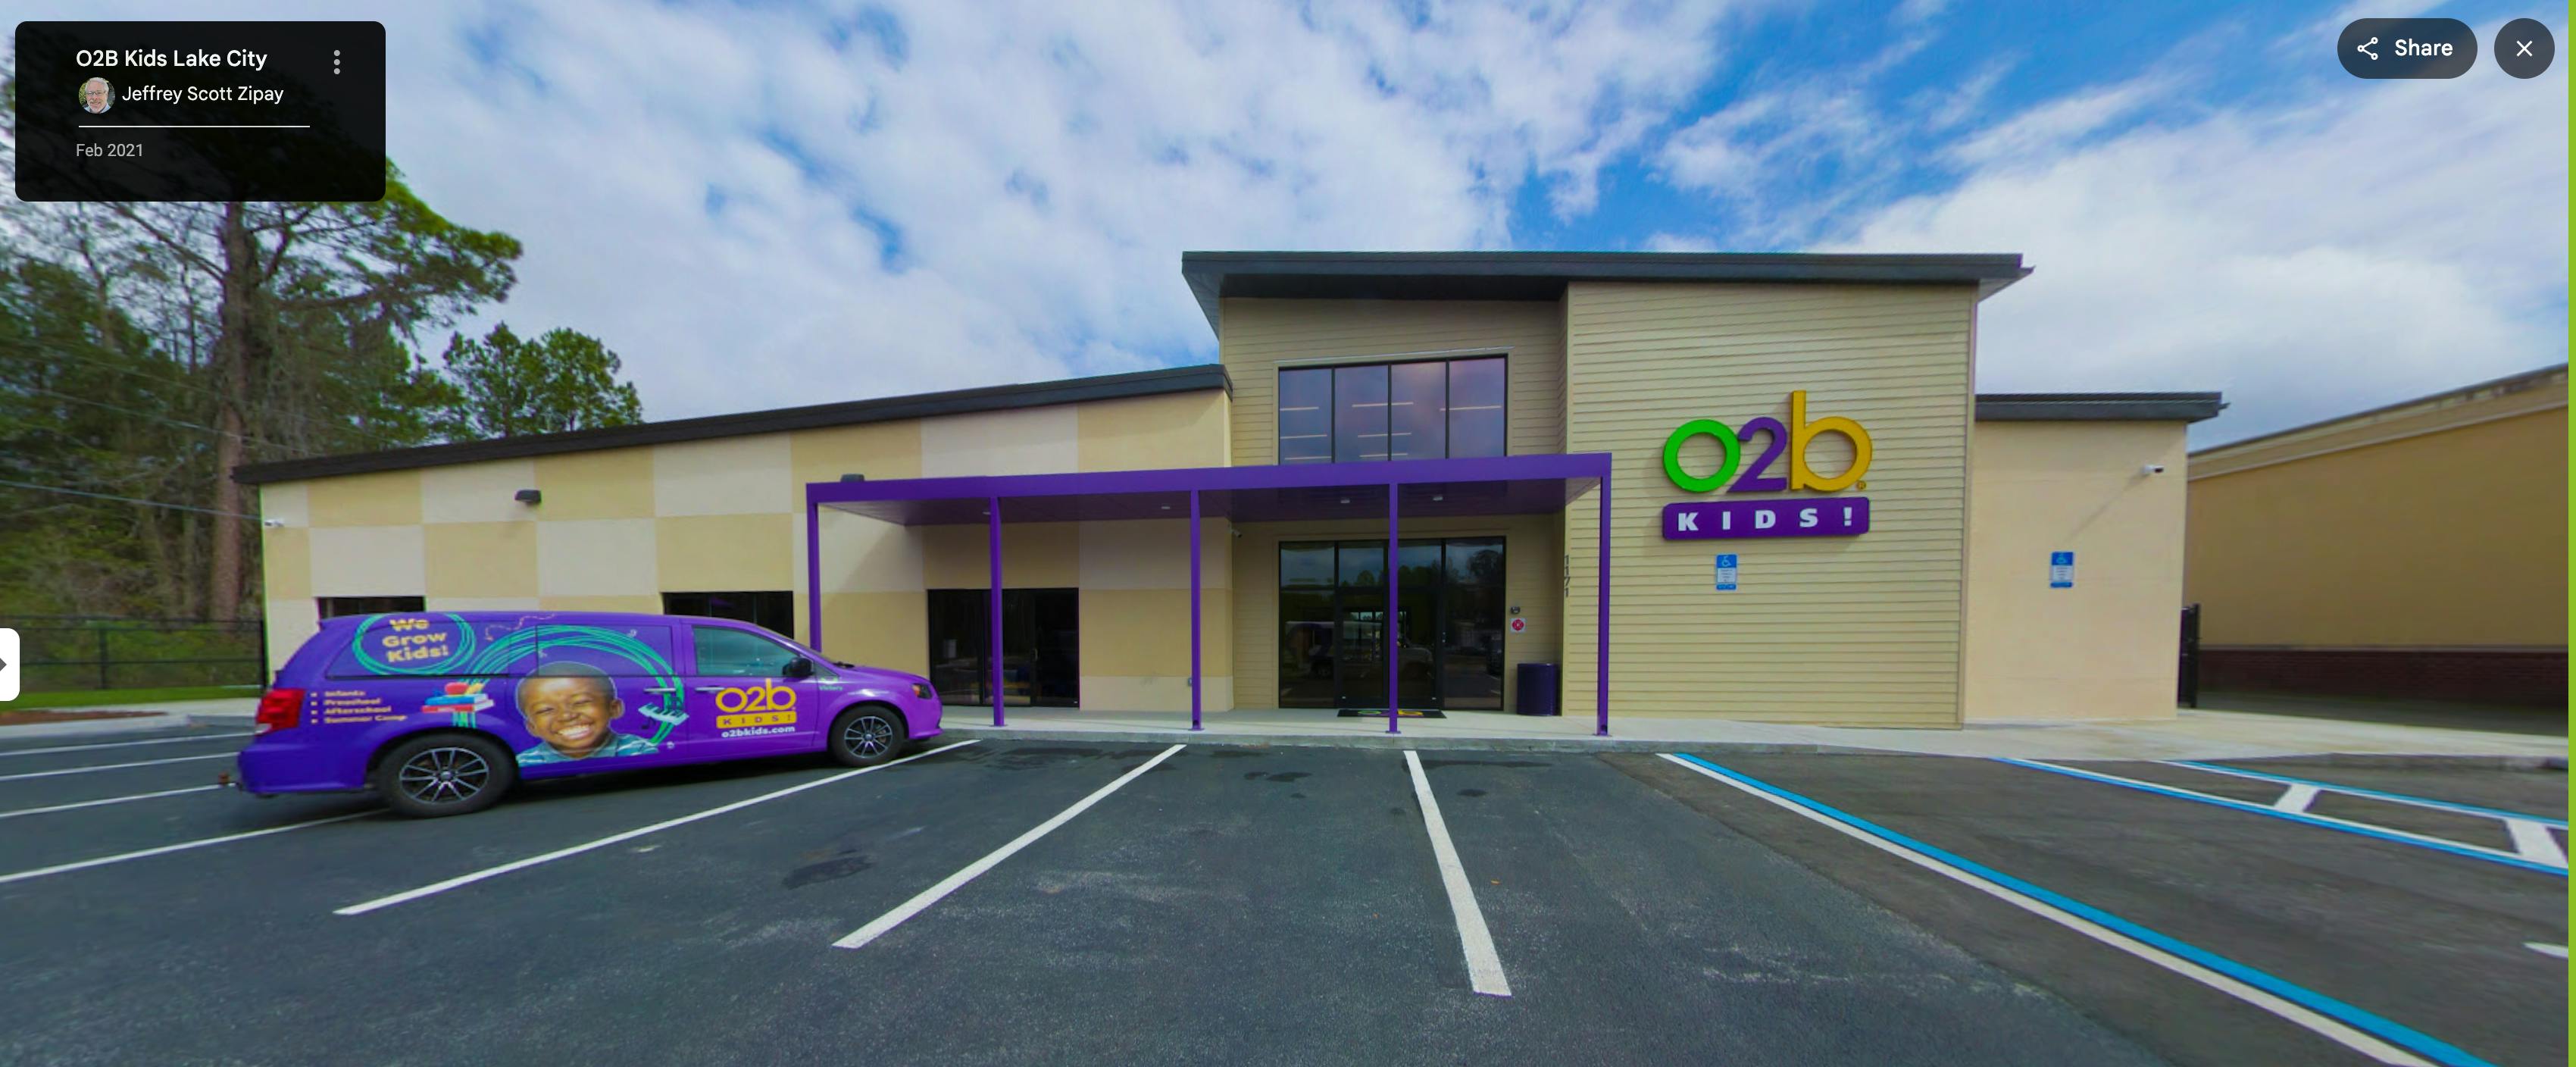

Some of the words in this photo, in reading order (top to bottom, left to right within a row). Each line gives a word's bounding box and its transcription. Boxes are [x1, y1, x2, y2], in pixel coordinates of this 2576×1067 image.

[1677, 506, 1853, 532] KIDS!
[389, 618, 430, 632] We
[382, 632, 447, 648] Grow
[386, 644, 449, 663] Kids!
[324, 706, 392, 715] Afterschool
[721, 726, 796, 738] o2bkids.com
